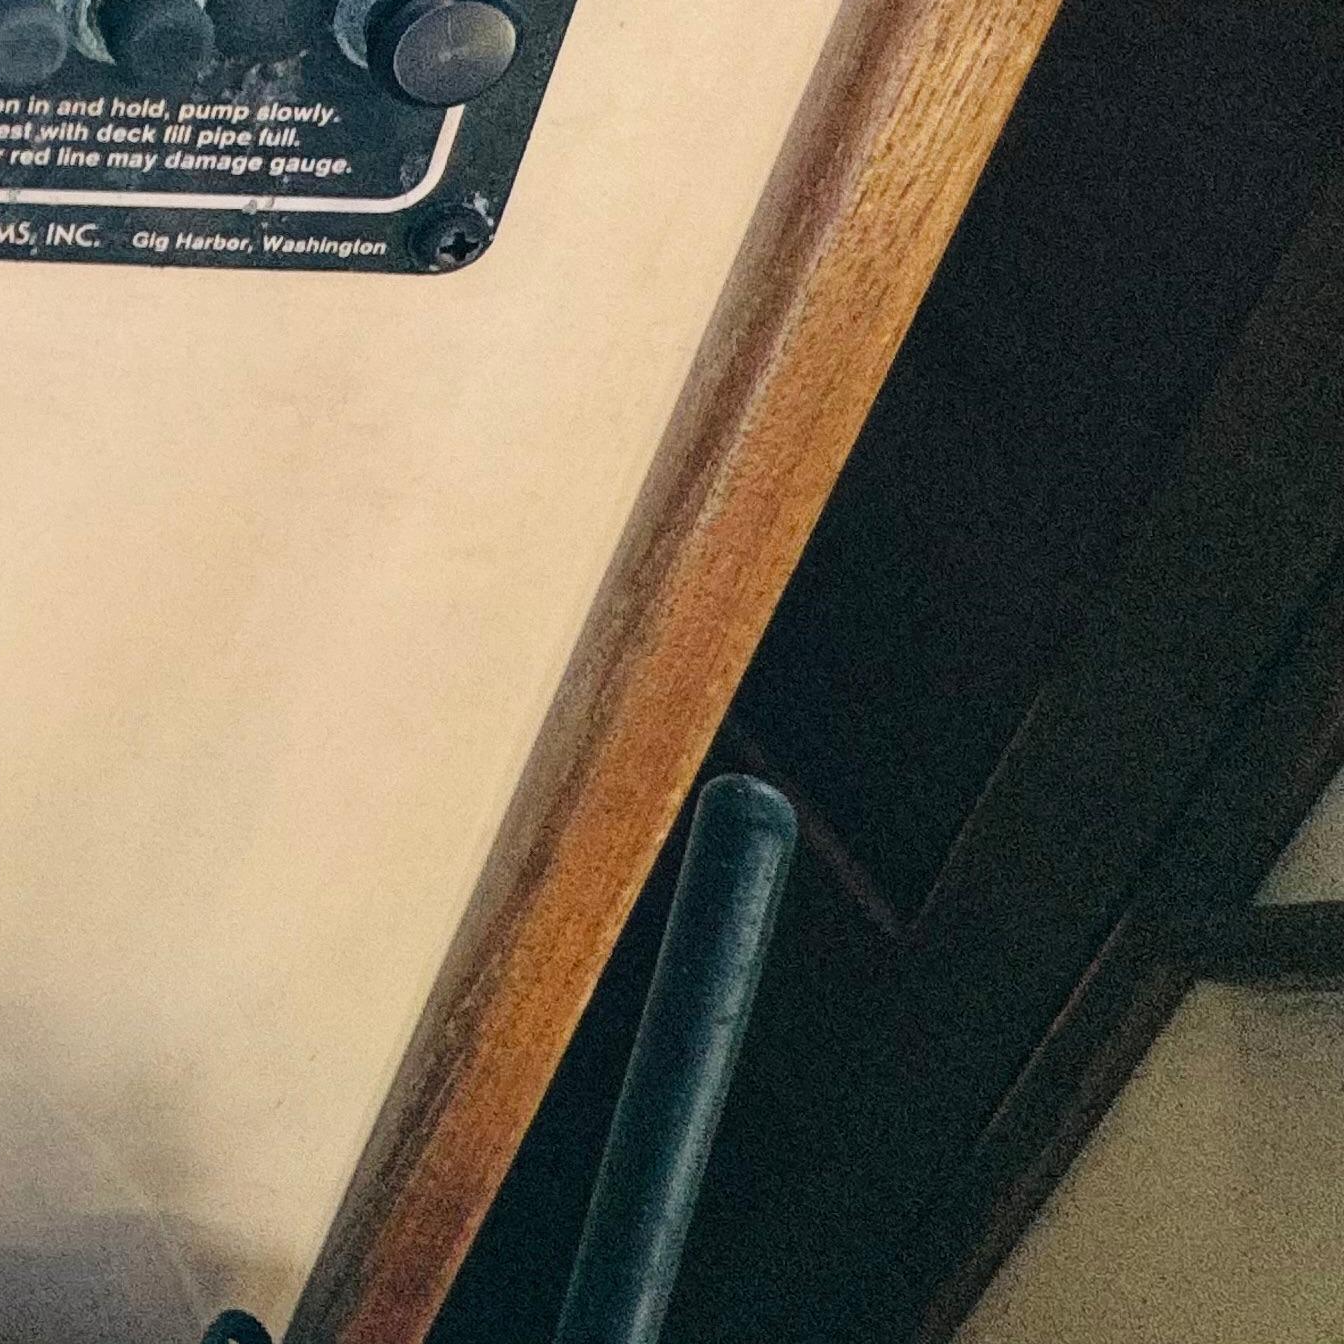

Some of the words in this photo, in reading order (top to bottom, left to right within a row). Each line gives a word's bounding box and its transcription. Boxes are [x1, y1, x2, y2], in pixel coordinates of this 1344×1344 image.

[27, 95, 50, 116] in
[56, 96, 105, 117] and
[110, 97, 170, 121] hold,
[177, 102, 249, 124] pump
[256, 101, 340, 127] slowly.
[39, 122, 89, 142] with
[96, 123, 156, 144] deck
[163, 124, 191, 145] fill
[196, 127, 252, 149] pipe
[258, 127, 300, 147] full.
[10, 146, 51, 166] red
[56, 146, 101, 167] line
[107, 152, 159, 173] may
[164, 151, 263, 176] damage
[269, 156, 352, 178] gauge.
[45, 222, 101, 249] INC.
[132, 230, 170, 253] Gig
[175, 231, 254, 253] Harbor,
[262, 234, 387, 258] Washington
